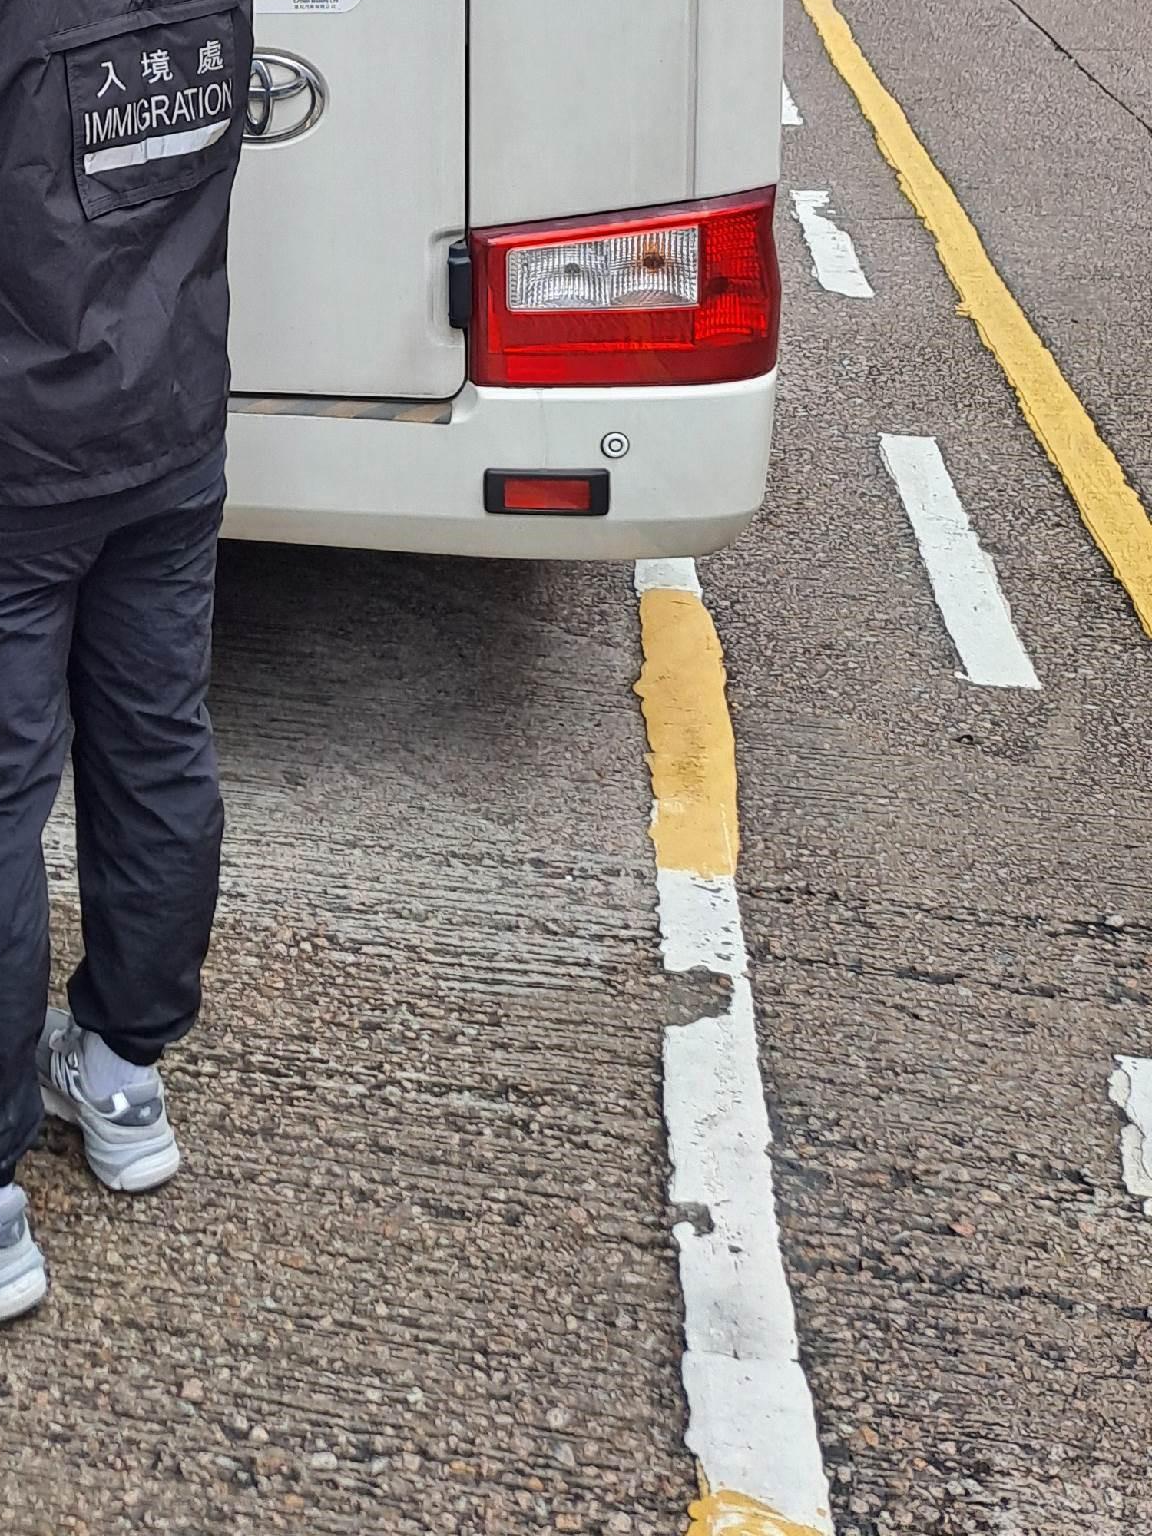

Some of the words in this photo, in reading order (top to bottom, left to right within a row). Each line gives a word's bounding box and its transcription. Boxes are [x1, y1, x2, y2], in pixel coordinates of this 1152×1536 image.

[96, 40, 224, 99] 入境處
[84, 78, 233, 146] IMMIGRATION
